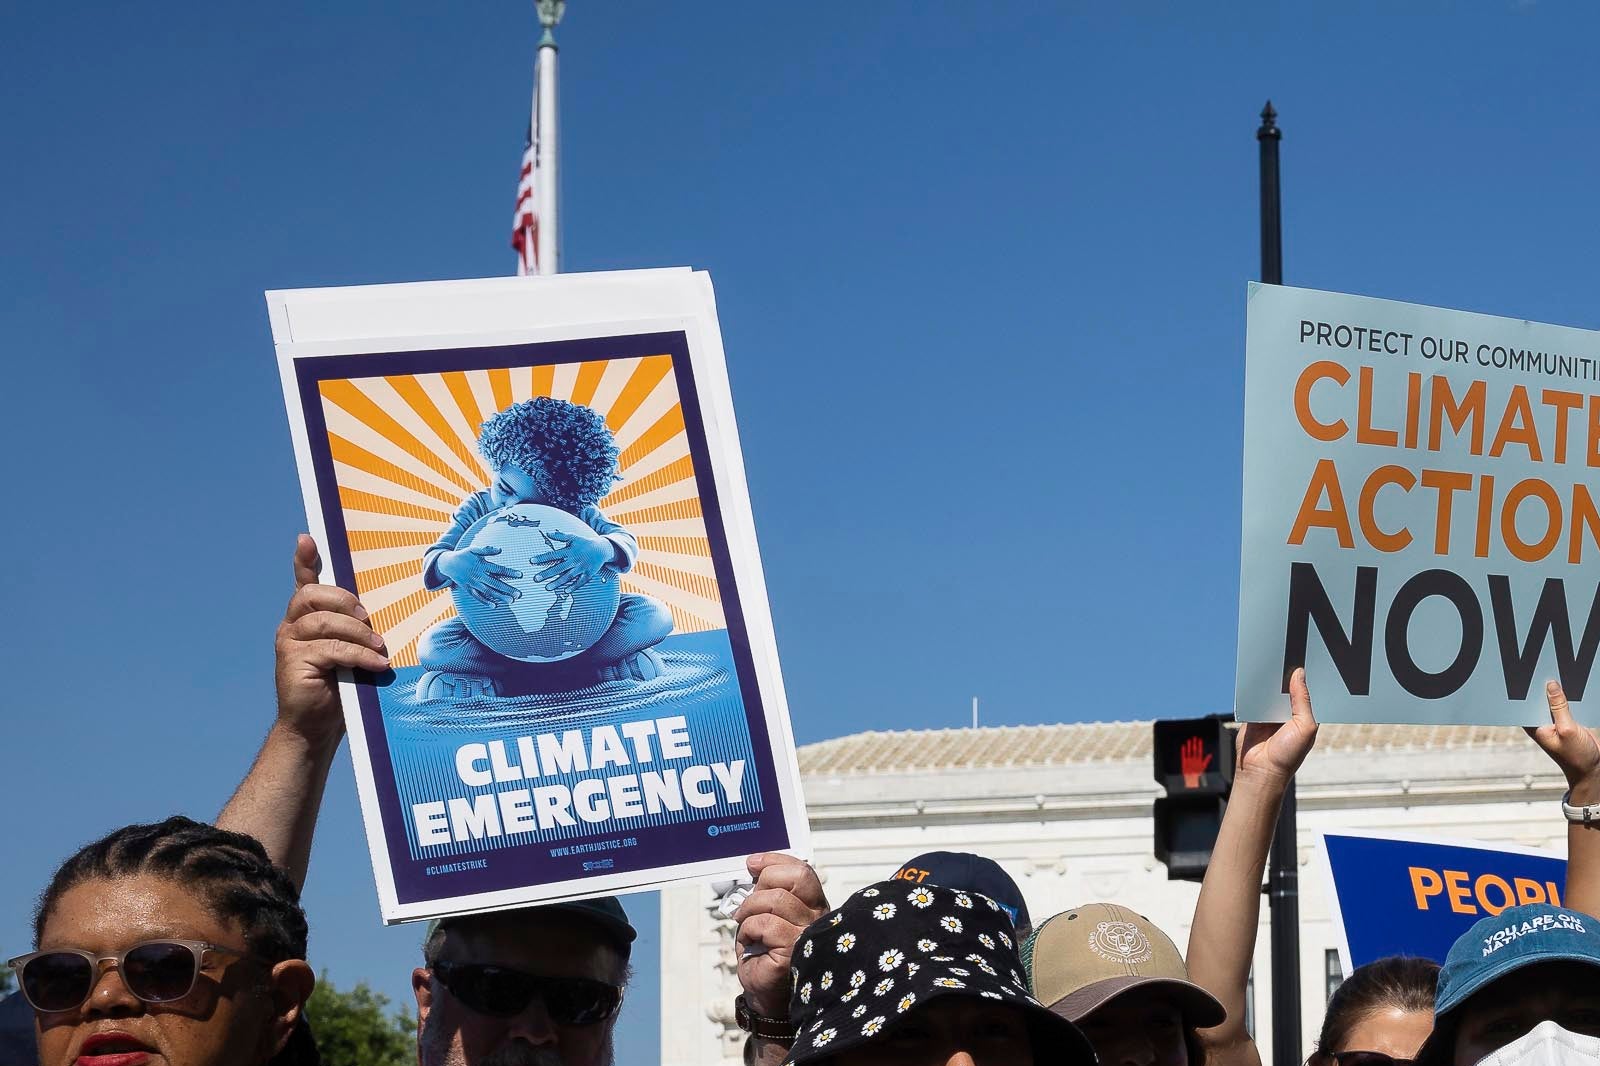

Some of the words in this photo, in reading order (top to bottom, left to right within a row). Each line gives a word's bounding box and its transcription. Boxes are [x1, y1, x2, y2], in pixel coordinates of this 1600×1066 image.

[1300, 320, 1413, 356] PROTECT
[1421, 335, 1469, 364] OUR
[455, 715, 693, 788] CLIMATE
[412, 759, 747, 848] EMERGENCY
[719, 821, 761, 834] EARTHJUSTICE
[550, 837, 638, 858] WWW.EARTHJUSTICE.ORG
[426, 859, 488, 876] #CLIMATESTRIKE
[1484, 924, 1517, 945] YOU
[1520, 914, 1555, 932] ARE
[1558, 914, 1582, 925] ON
[1543, 922, 1586, 934] LAND
